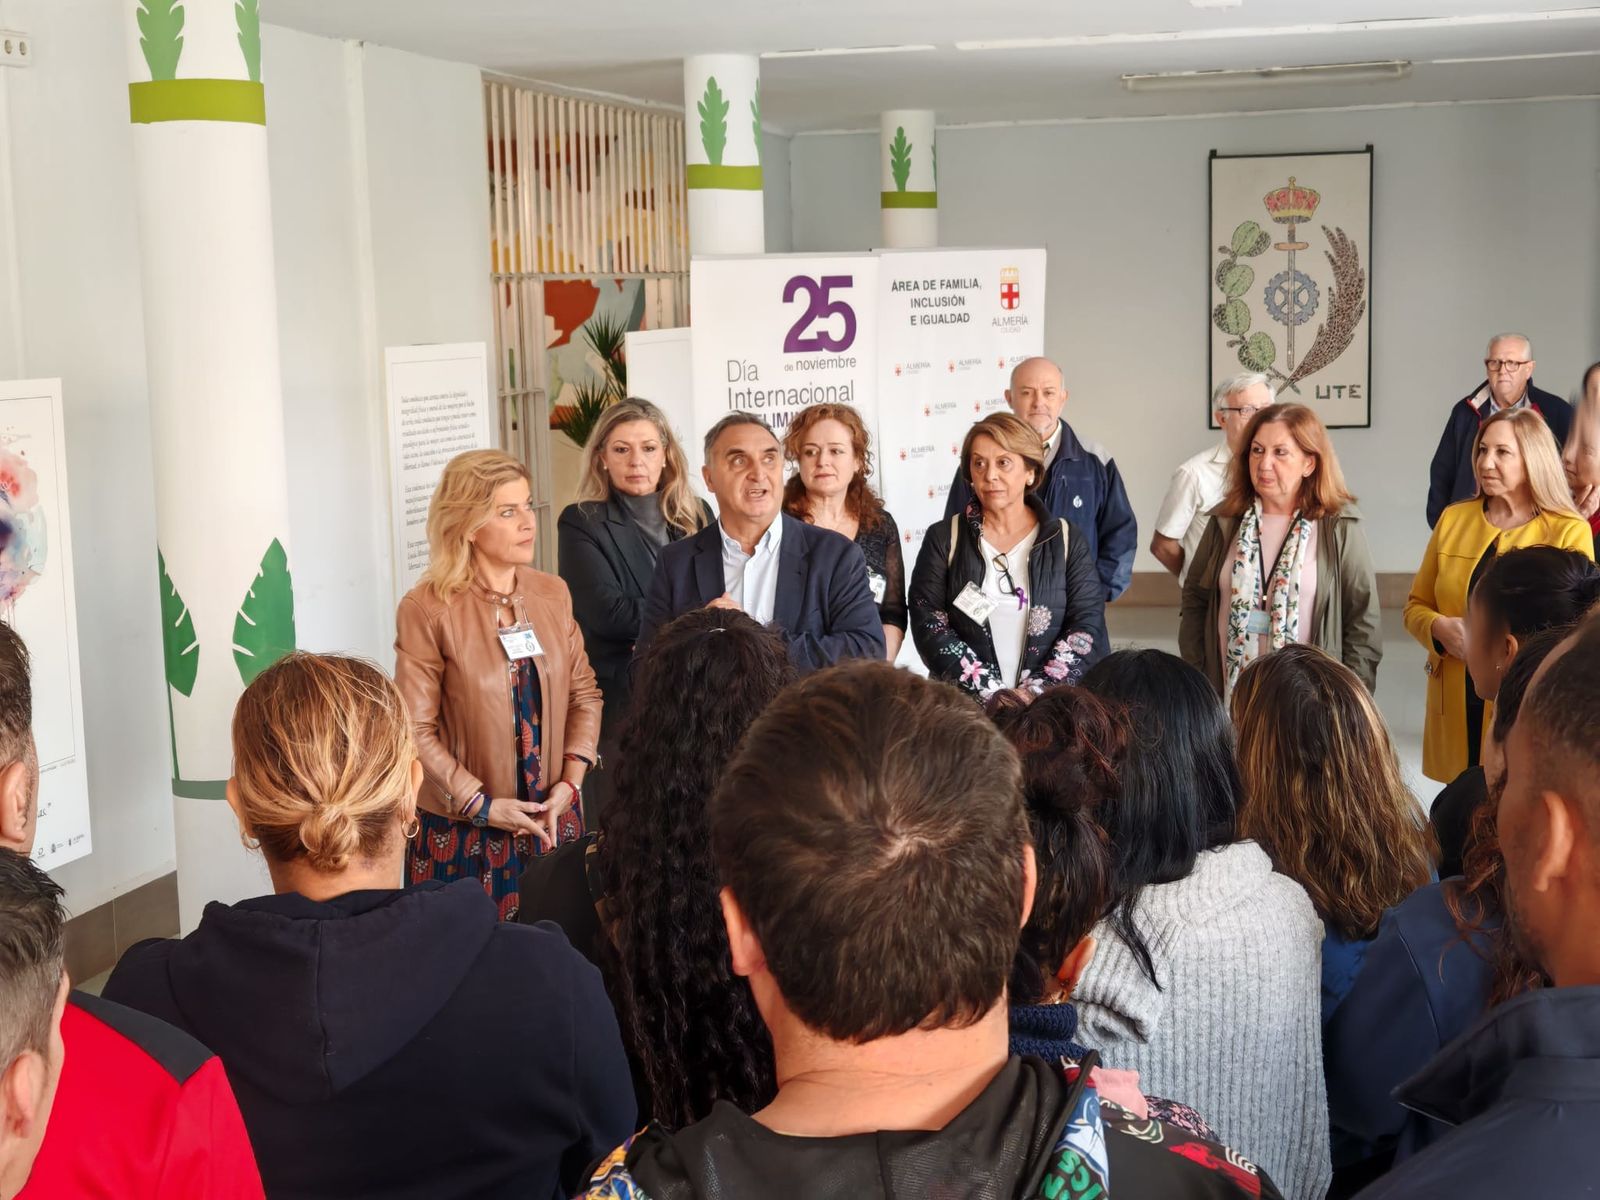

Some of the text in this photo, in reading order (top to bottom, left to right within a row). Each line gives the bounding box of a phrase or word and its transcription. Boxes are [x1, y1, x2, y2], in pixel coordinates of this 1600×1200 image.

[891, 278, 982, 292] ÁREA DE FAMILIA,
[910, 294, 965, 308] INCLUSIÓN
[782, 275, 857, 353] 25
[910, 312, 970, 326] E IGUALDAD
[992, 315, 1028, 327] ALMERÍA
[727, 359, 759, 382] Día
[784, 356, 857, 371] de noviembre
[728, 380, 854, 410] Internacional
[1315, 384, 1361, 399] UTE
